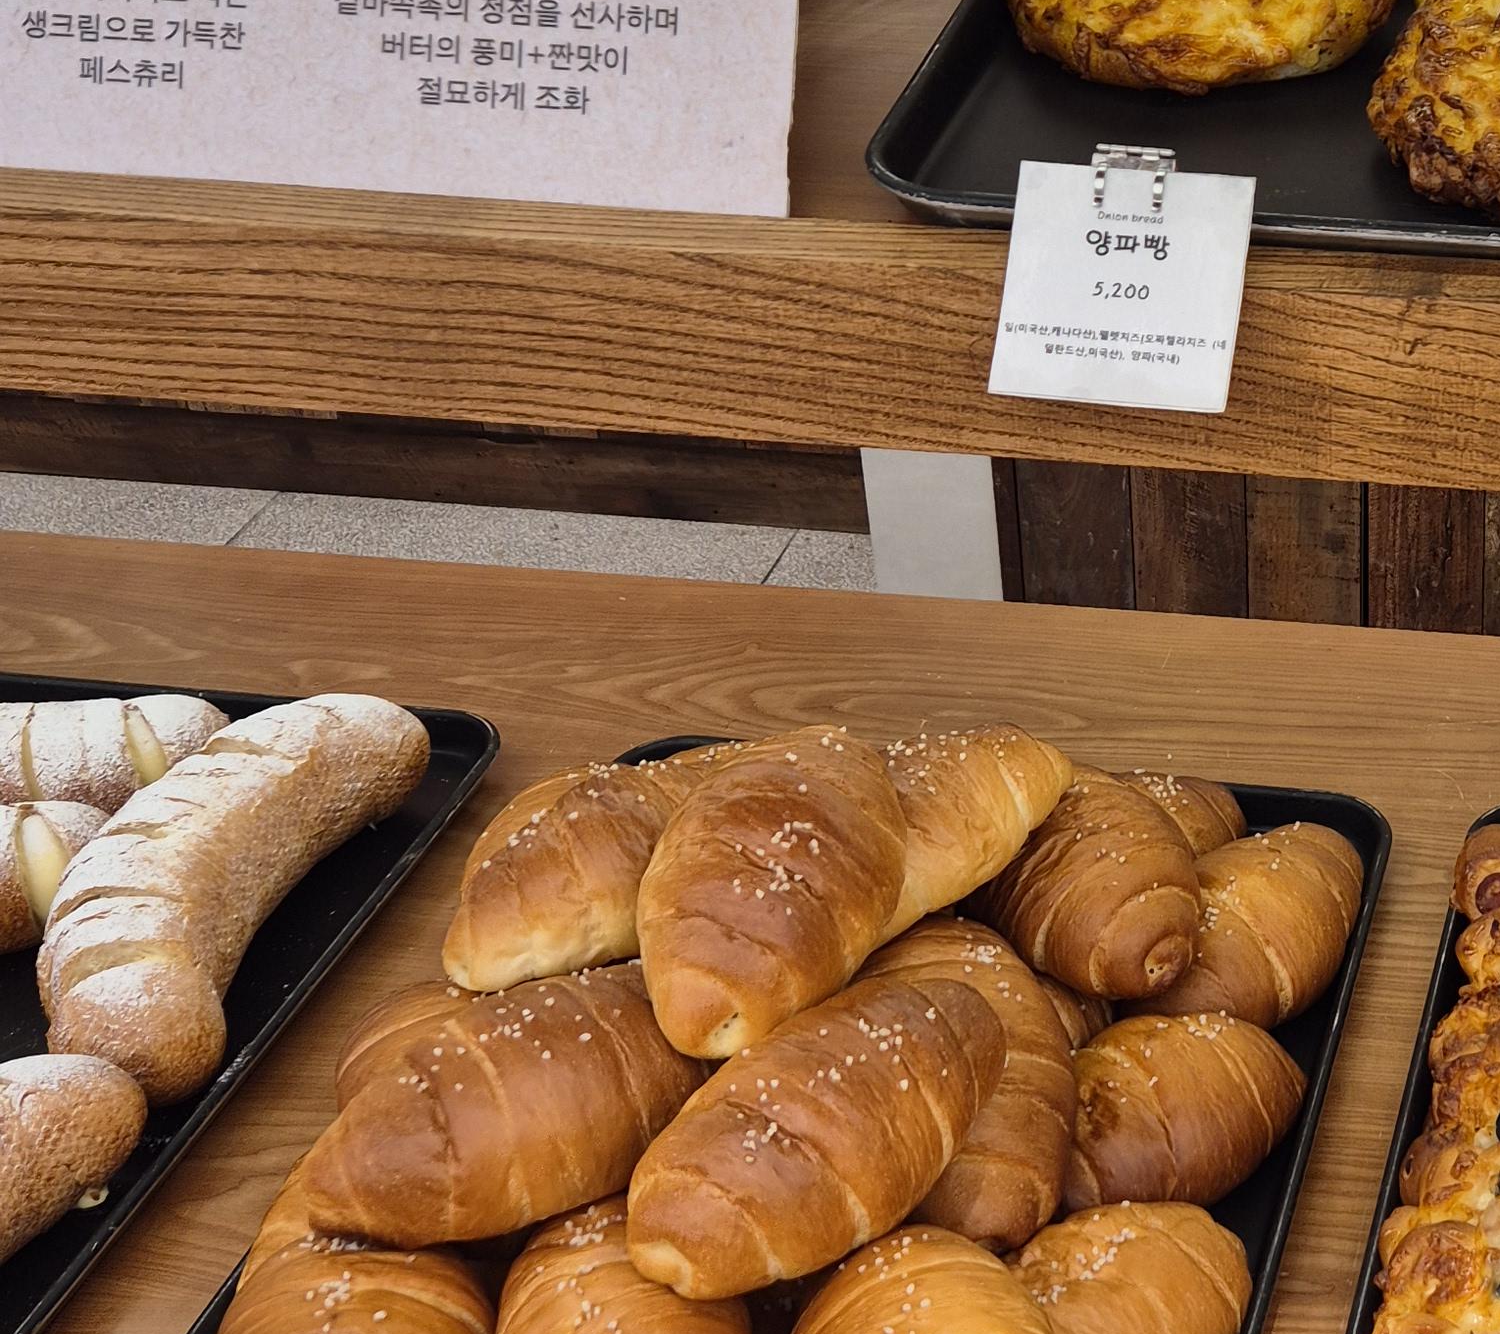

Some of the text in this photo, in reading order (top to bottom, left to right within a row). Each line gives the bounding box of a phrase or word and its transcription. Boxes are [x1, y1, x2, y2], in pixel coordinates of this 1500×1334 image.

[21, 10, 246, 50] 생크림으로 가득찬
[570, 1, 680, 36] 선사하며
[381, 32, 628, 75] 버터의 풍미+짠맛이
[79, 56, 184, 90] 페스츄리
[417, 76, 590, 114] 절묘하게 조화
[1132, 213, 1164, 225] bread
[1086, 229, 1170, 261] 양파빵
[1092, 281, 1150, 300] 5,200
